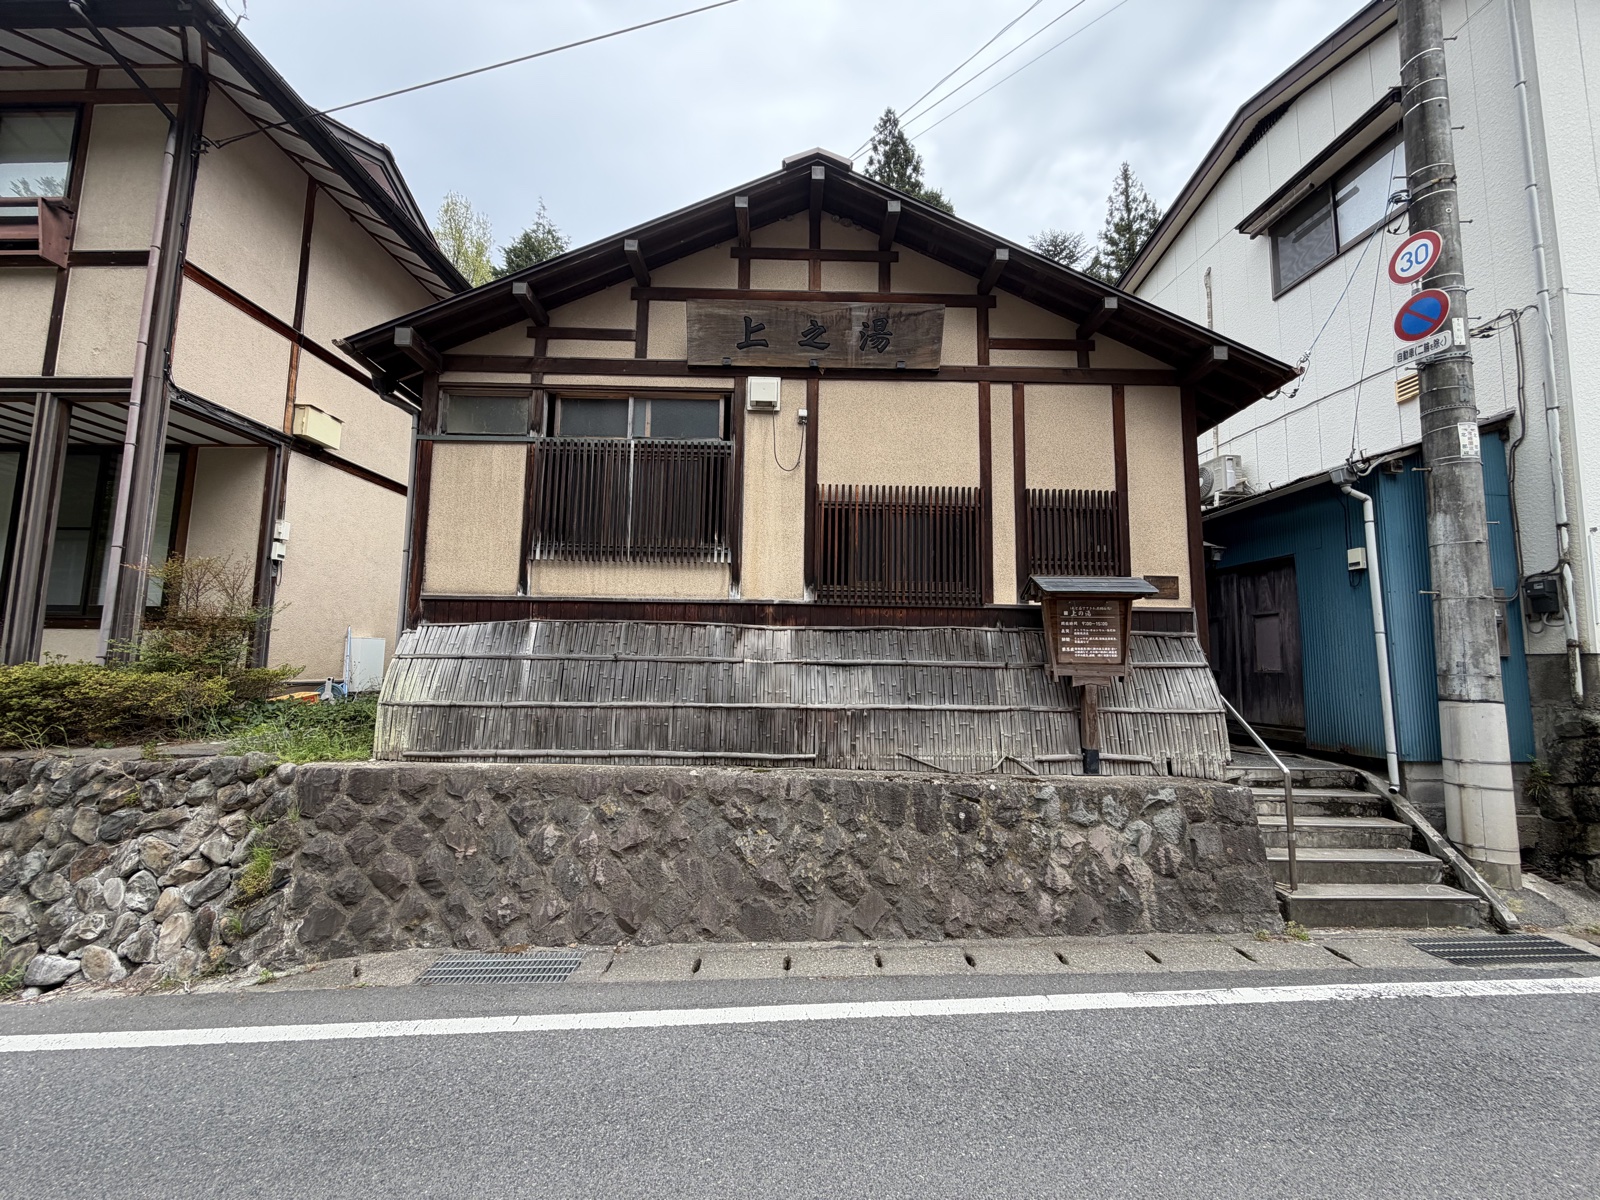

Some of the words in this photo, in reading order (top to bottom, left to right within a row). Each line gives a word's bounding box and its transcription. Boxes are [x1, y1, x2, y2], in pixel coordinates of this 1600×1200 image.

[1400, 243, 1429, 272] 30
[736, 316, 893, 353] 上之湯
